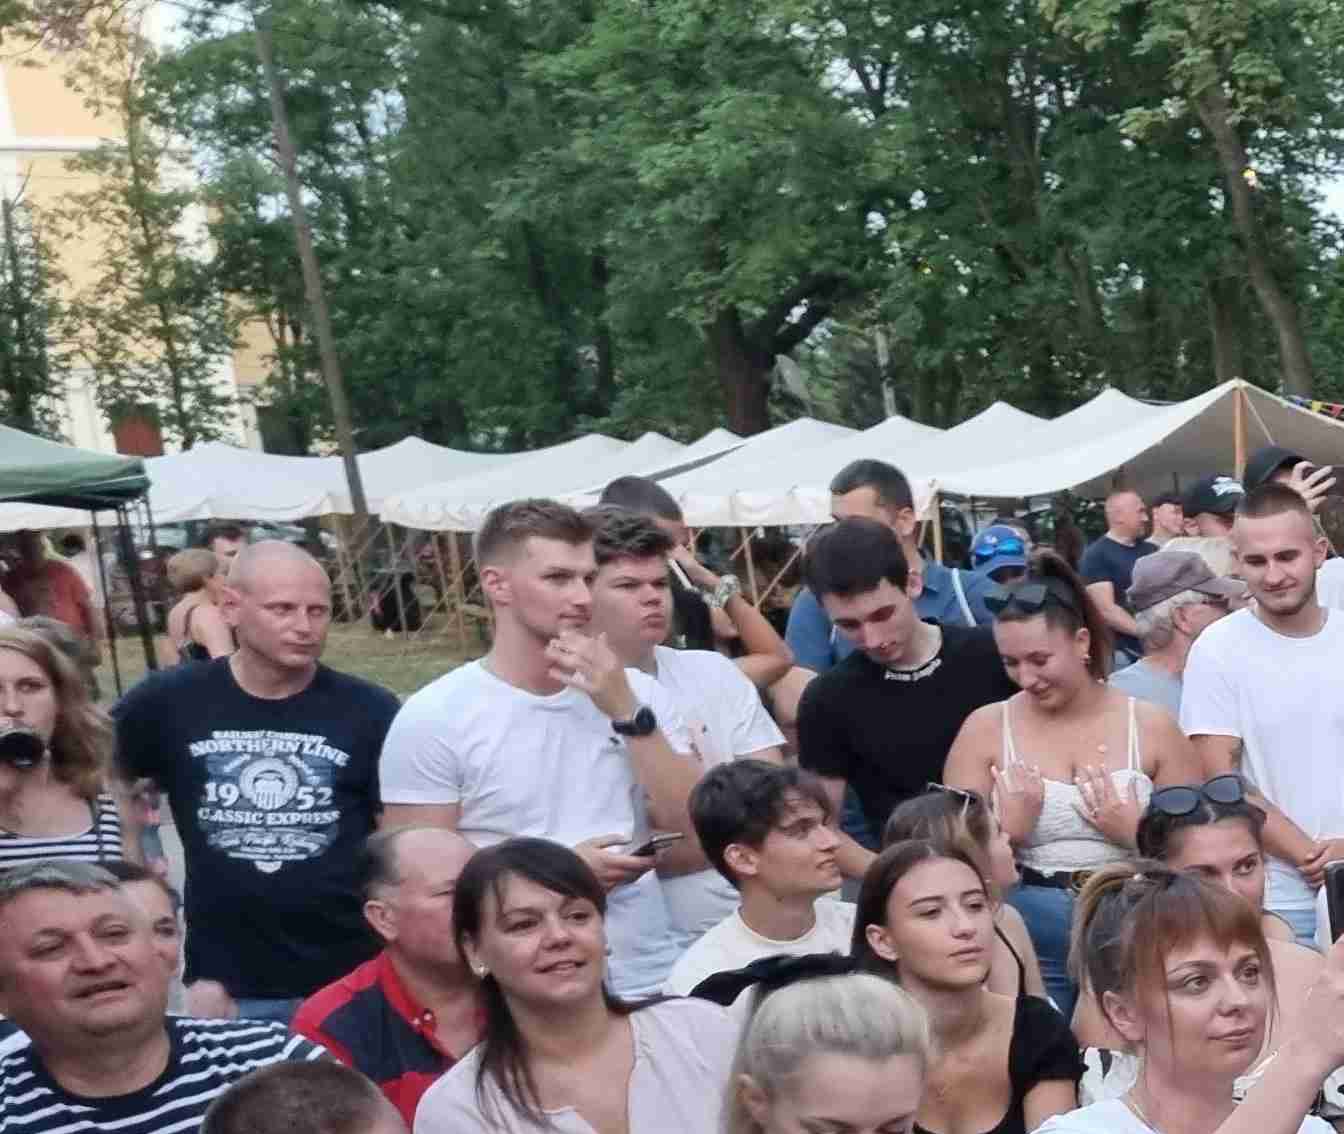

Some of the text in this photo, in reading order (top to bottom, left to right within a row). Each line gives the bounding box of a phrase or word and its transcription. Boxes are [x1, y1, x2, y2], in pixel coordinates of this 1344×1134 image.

[188, 738, 350, 767] NORTHERN LINE
[205, 782, 334, 810] 19 52
[197, 807, 341, 825] CLASSIC EXPRESS
